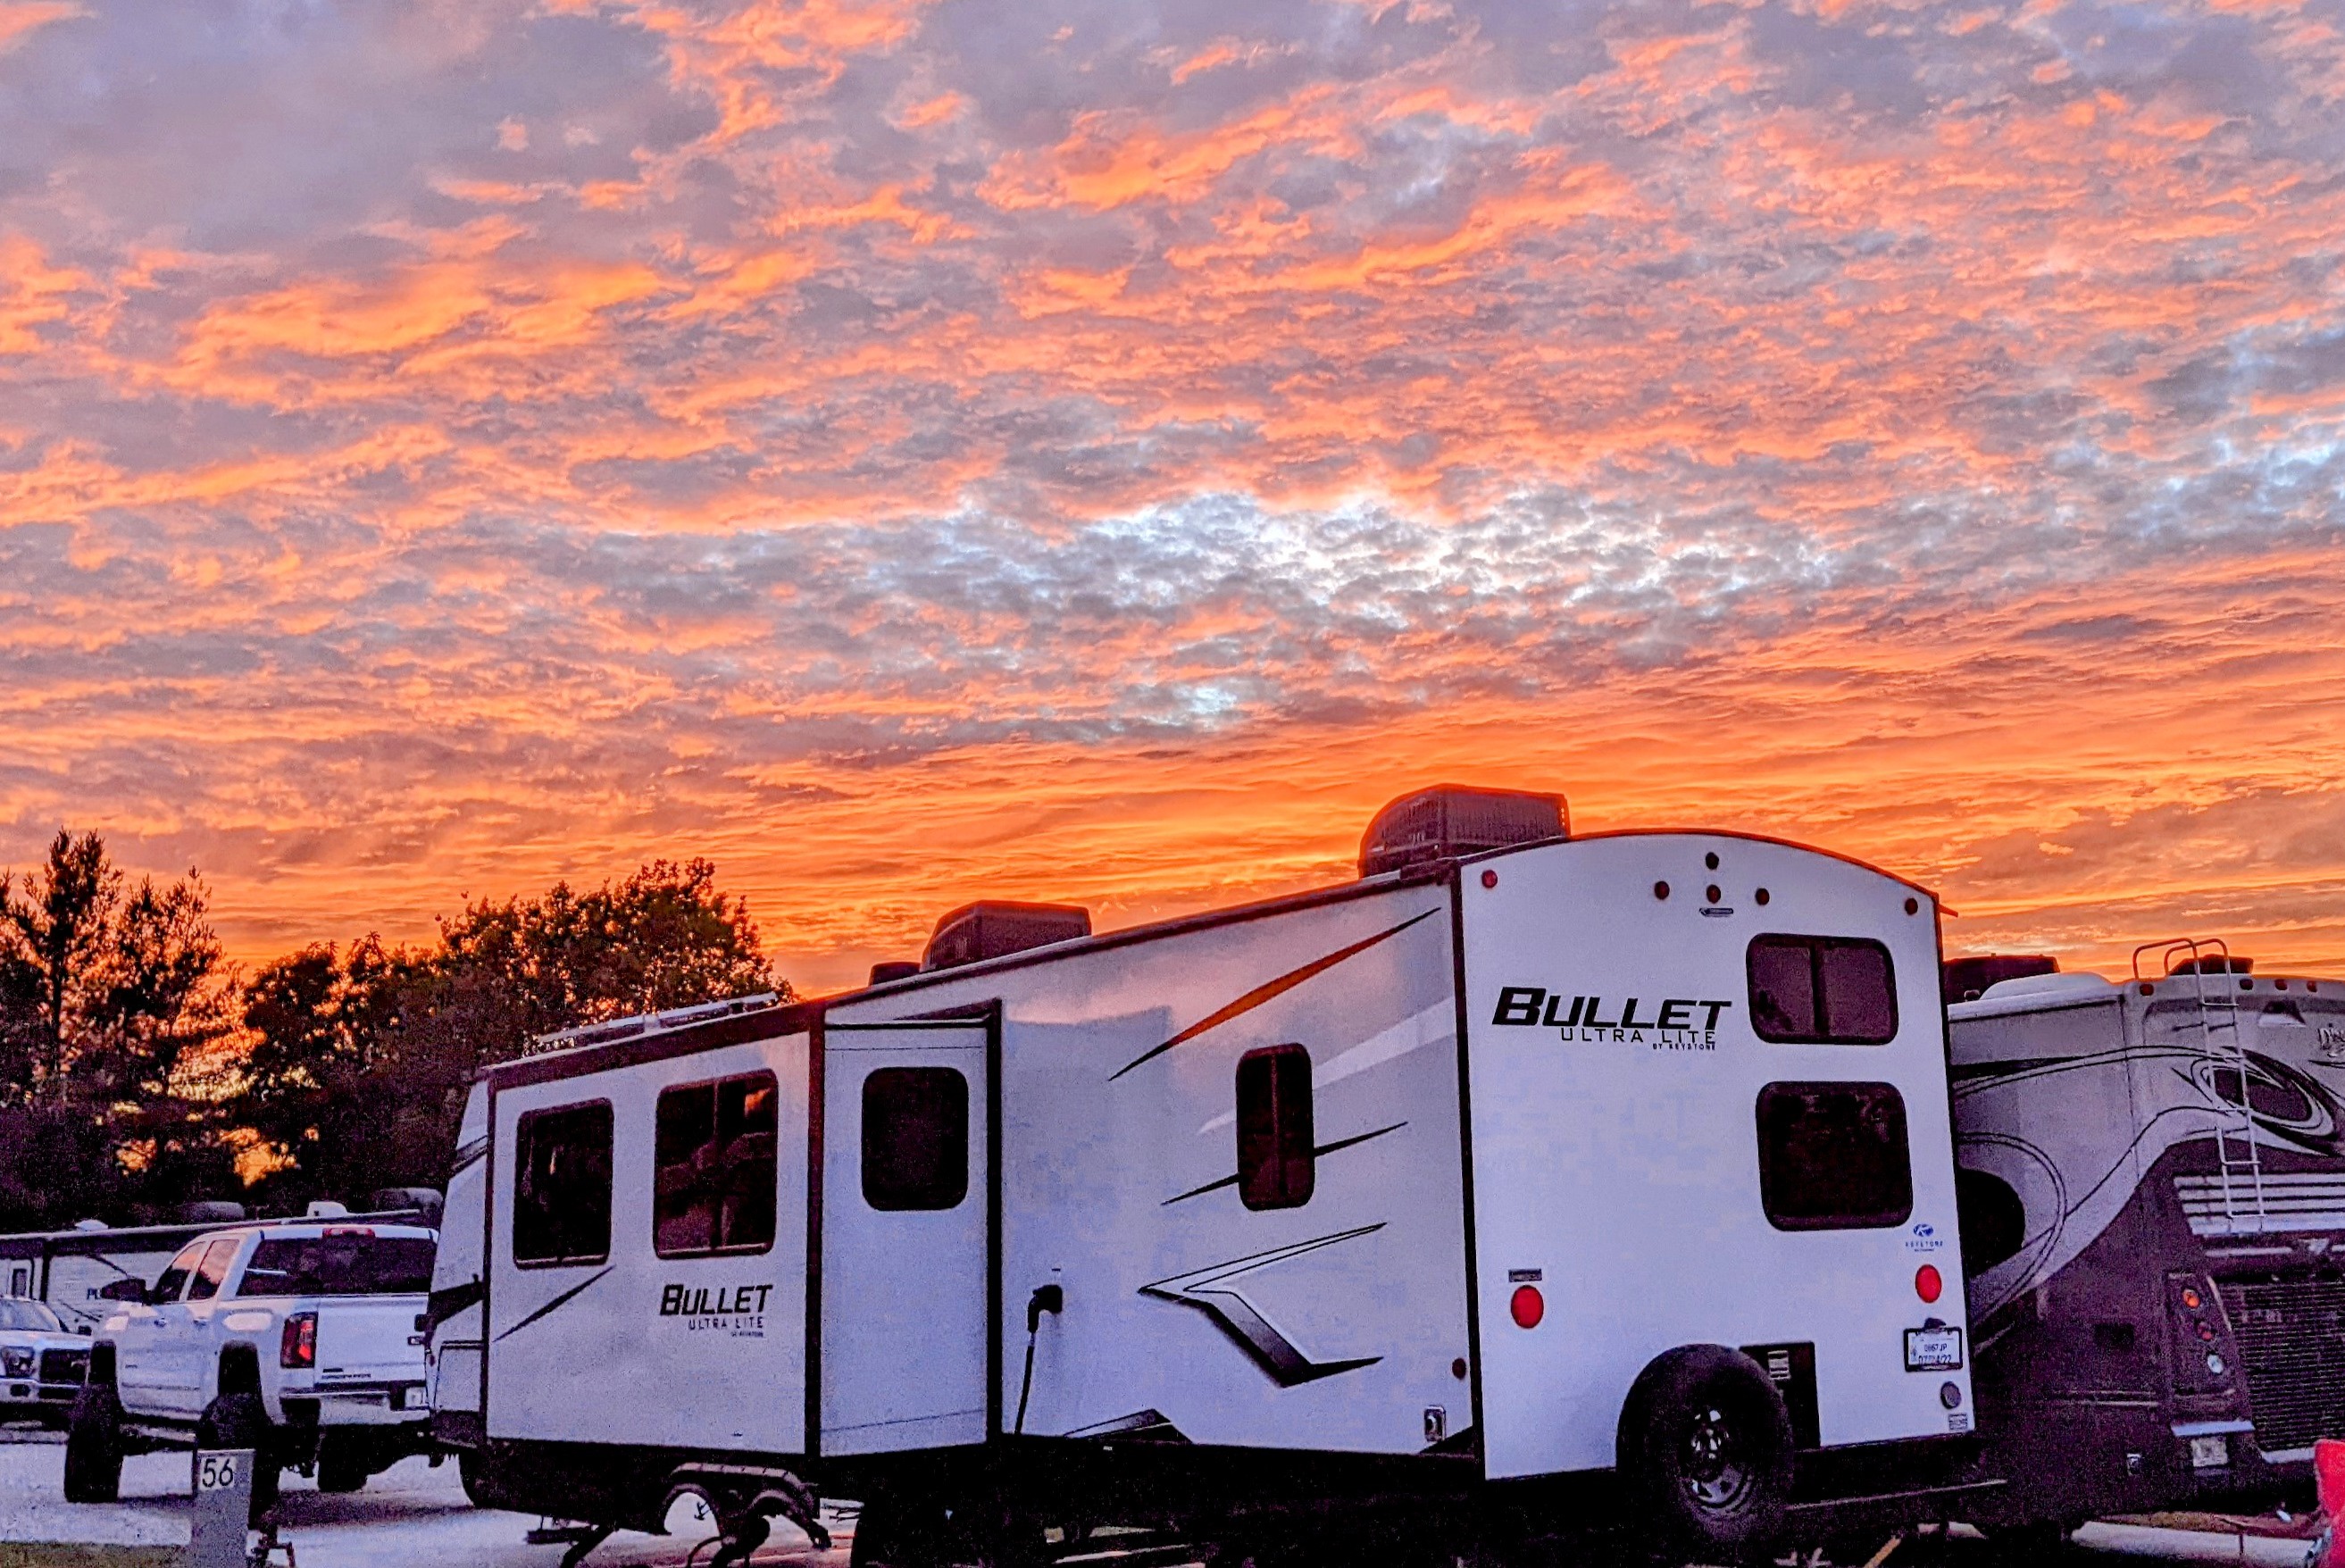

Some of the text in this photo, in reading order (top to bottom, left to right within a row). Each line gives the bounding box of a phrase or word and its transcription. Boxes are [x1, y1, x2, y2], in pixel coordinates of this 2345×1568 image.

[1492, 986, 1732, 1030] BULLET
[1560, 1027, 1716, 1045] ULTRA LITE
[659, 1284, 774, 1316] BULLET
[688, 1316, 764, 1330] ULTRA LITE
[202, 1457, 234, 1488] 56
